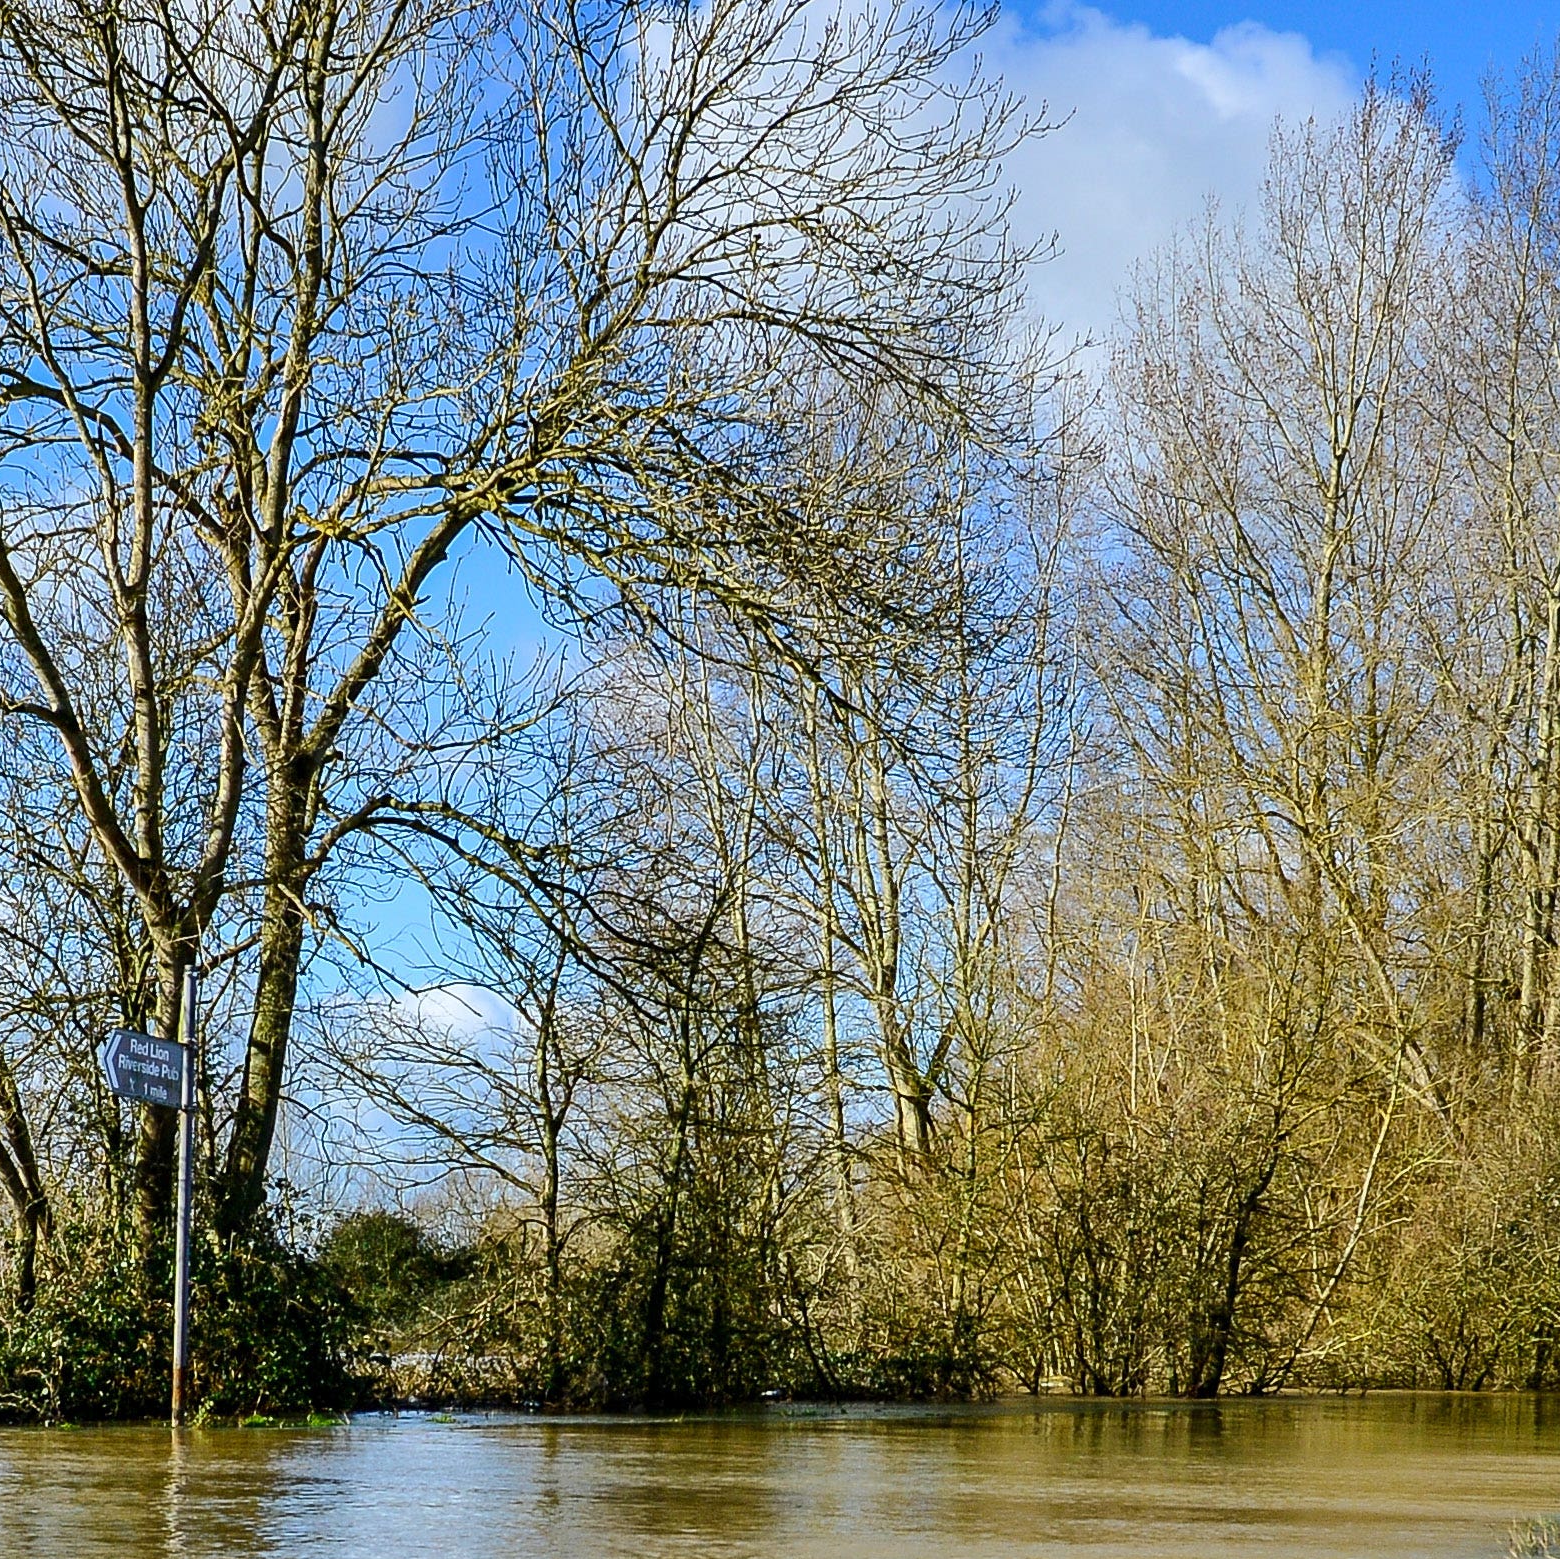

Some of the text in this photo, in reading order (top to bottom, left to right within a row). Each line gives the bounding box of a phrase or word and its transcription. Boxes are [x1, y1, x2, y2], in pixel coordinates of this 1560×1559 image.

[130, 1038, 169, 1061] Red Lion
[118, 1054, 179, 1081] Riverside Pub
[143, 1082, 168, 1100] 1 mile
